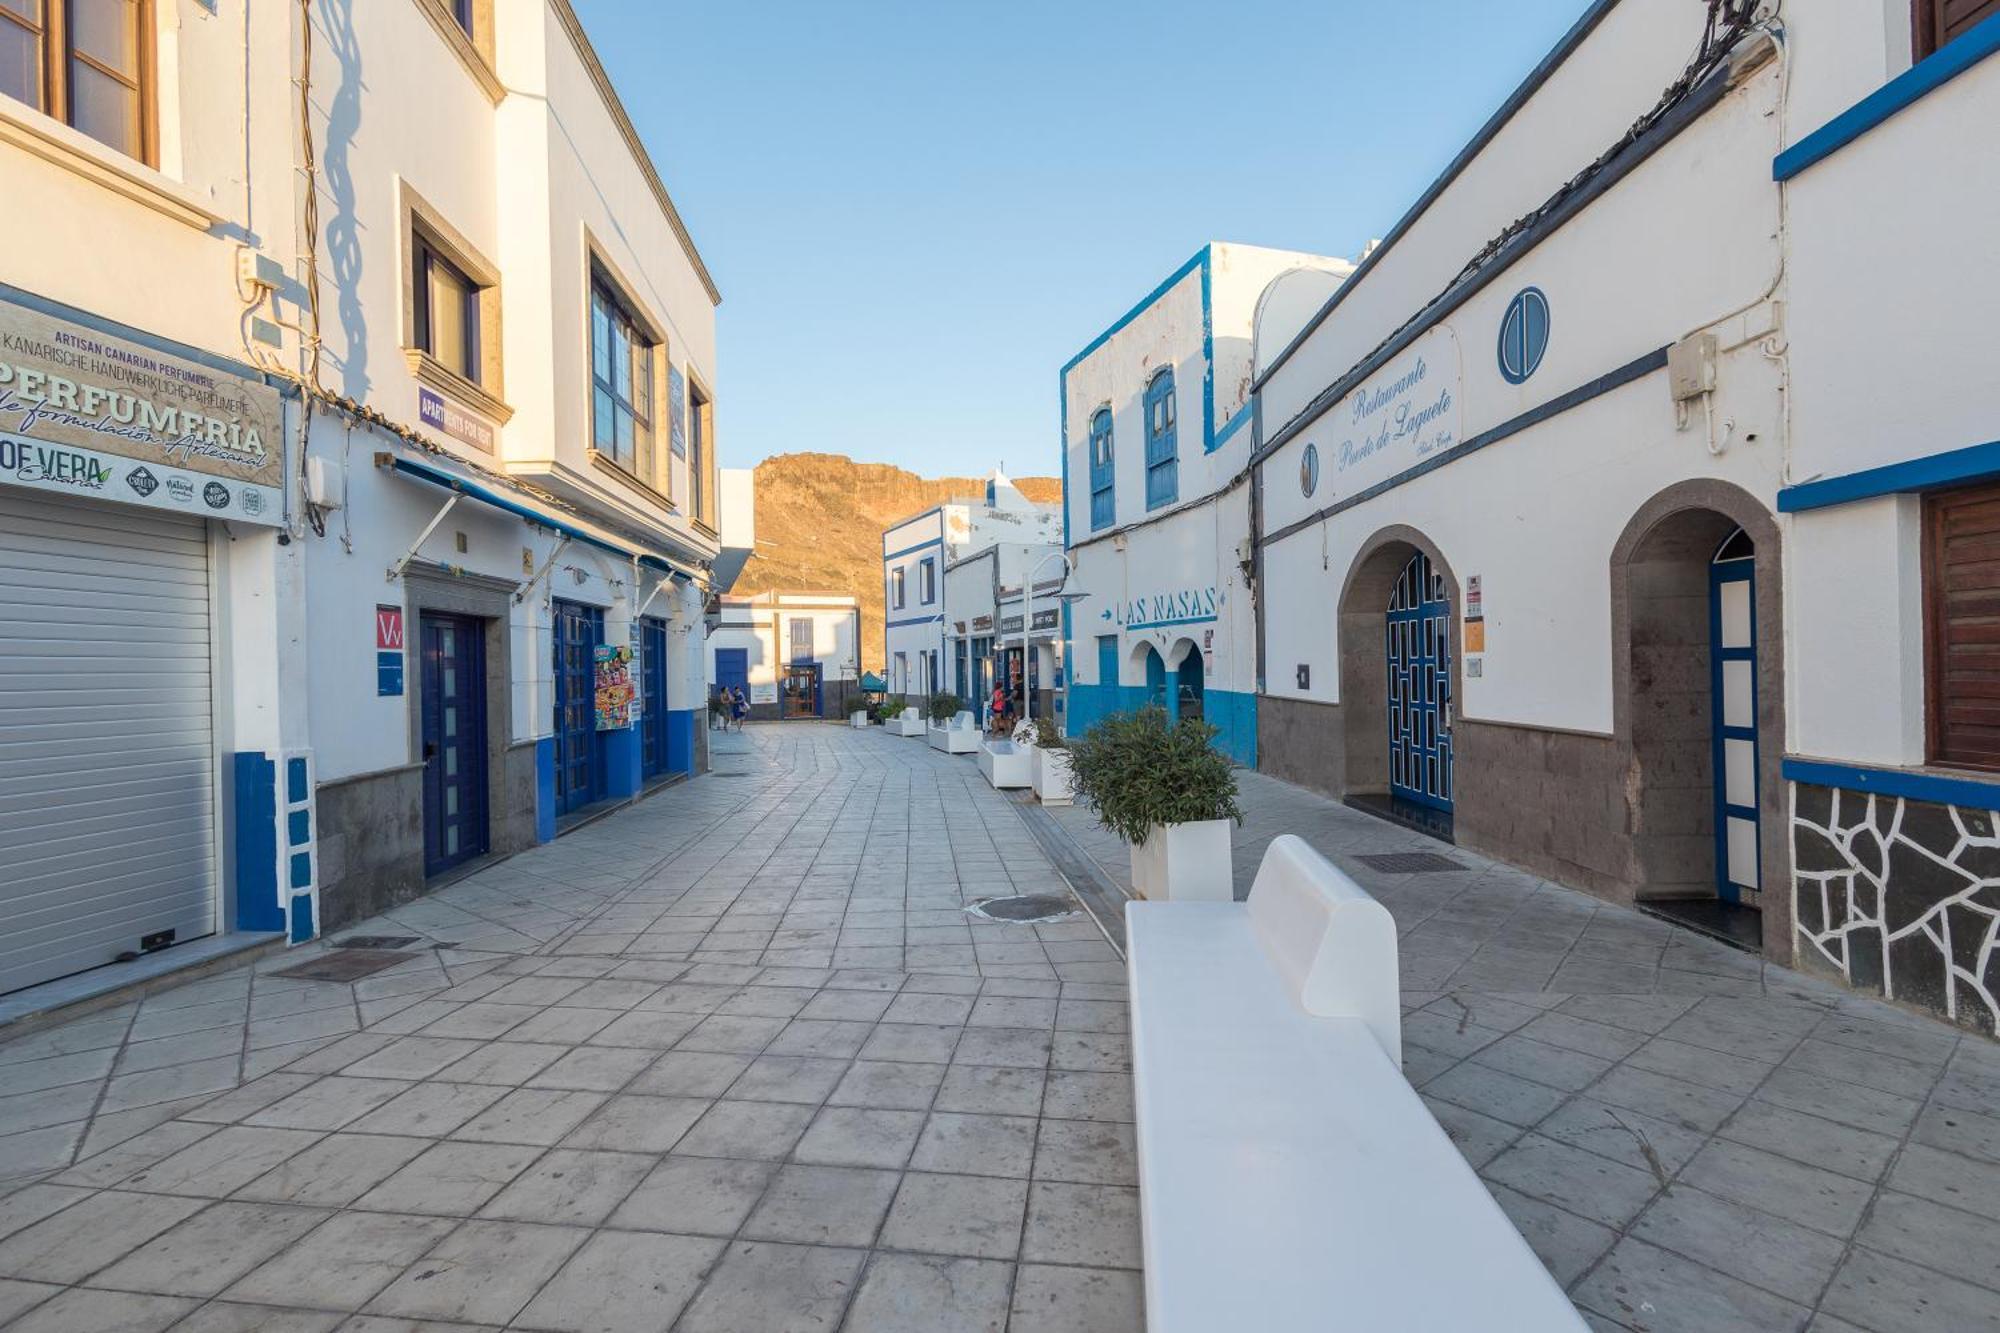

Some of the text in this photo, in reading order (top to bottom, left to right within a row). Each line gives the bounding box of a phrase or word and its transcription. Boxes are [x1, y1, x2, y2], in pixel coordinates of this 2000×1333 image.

[3, 333, 89, 372] KANARISCHE
[55, 331, 102, 355] ARTISAN
[104, 346, 157, 372] CANARIAN
[0, 361, 265, 455] PERFUMERÍA
[1352, 356, 1426, 425] Restaurante
[38, 447, 102, 482] VERA
[1337, 437, 1375, 473] Puerto
[1376, 419, 1391, 450] de
[1116, 587, 1216, 626] LAS NASAS
